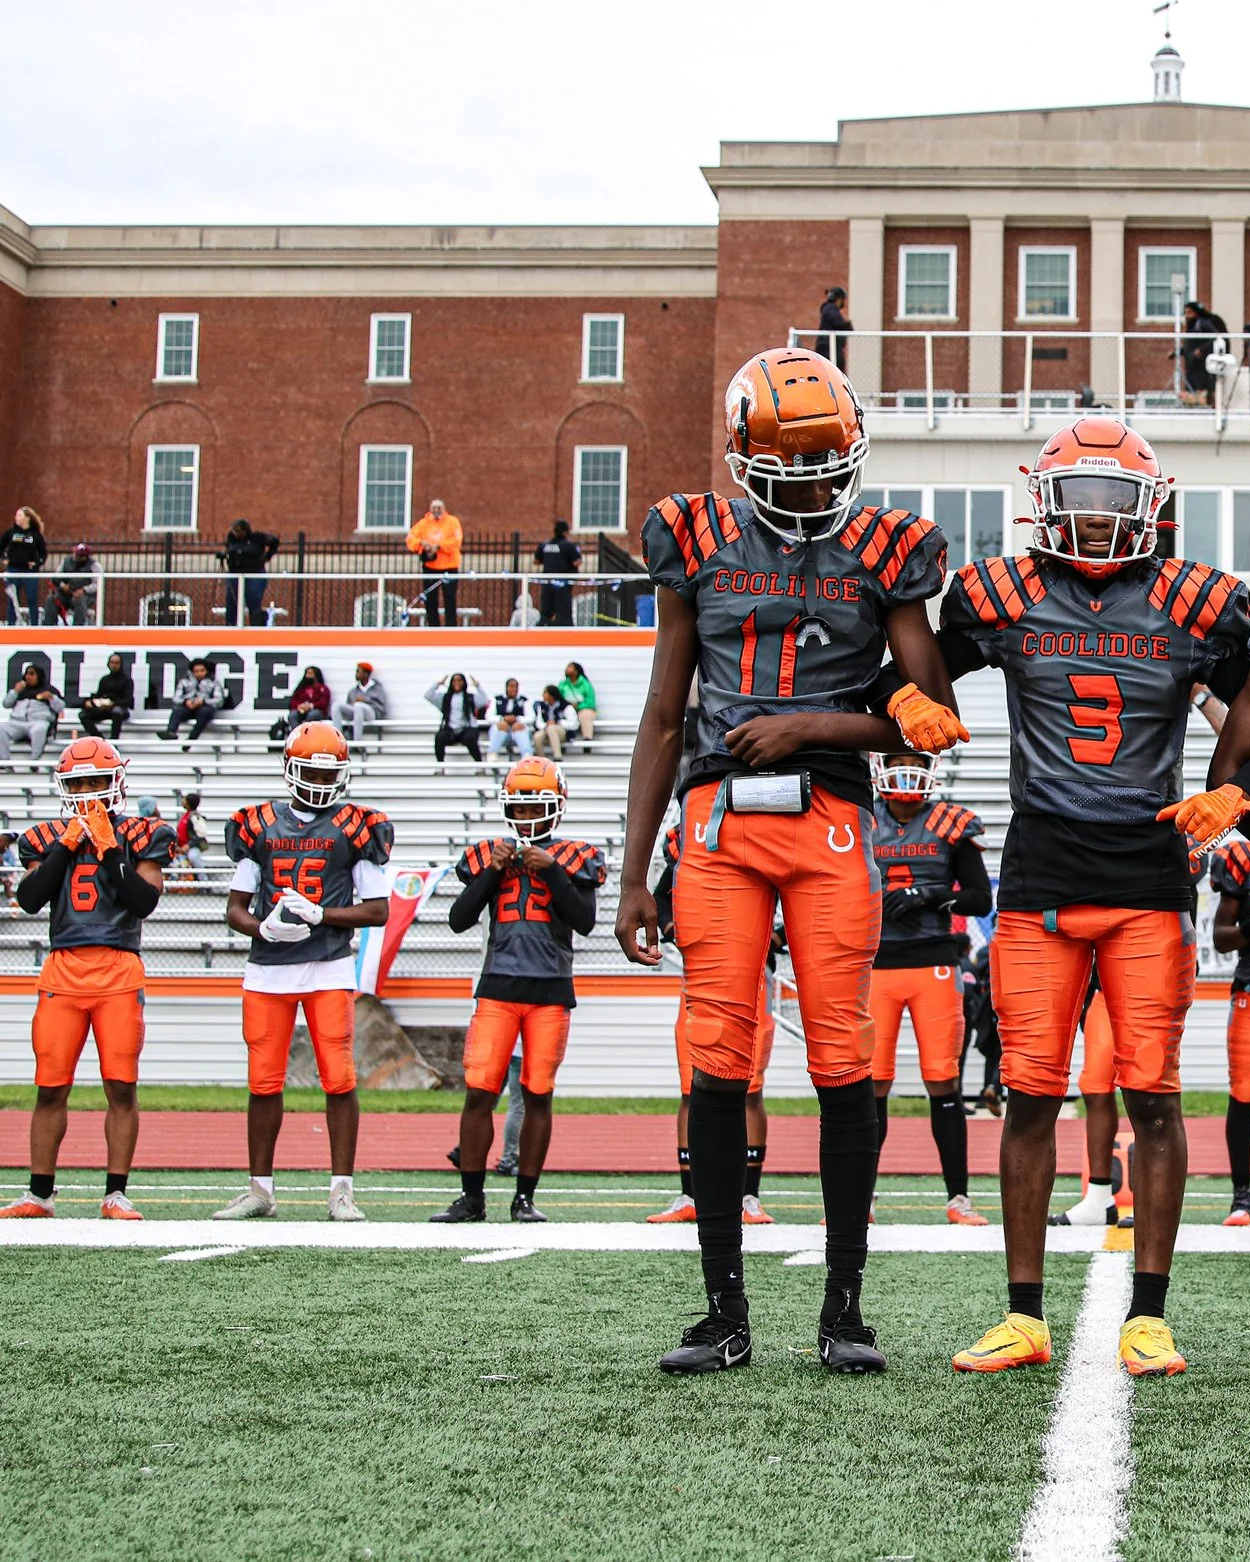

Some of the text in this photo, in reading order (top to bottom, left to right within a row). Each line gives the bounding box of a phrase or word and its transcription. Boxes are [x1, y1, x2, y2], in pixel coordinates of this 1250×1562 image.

[1080, 458, 1117, 467] Riddell
[739, 605, 802, 698] 11
[1022, 632, 1170, 661] COOLIDGE
[1065, 673, 1126, 767] 3
[70, 863, 100, 912] 6
[272, 857, 328, 905] 56
[497, 876, 553, 924] 22
